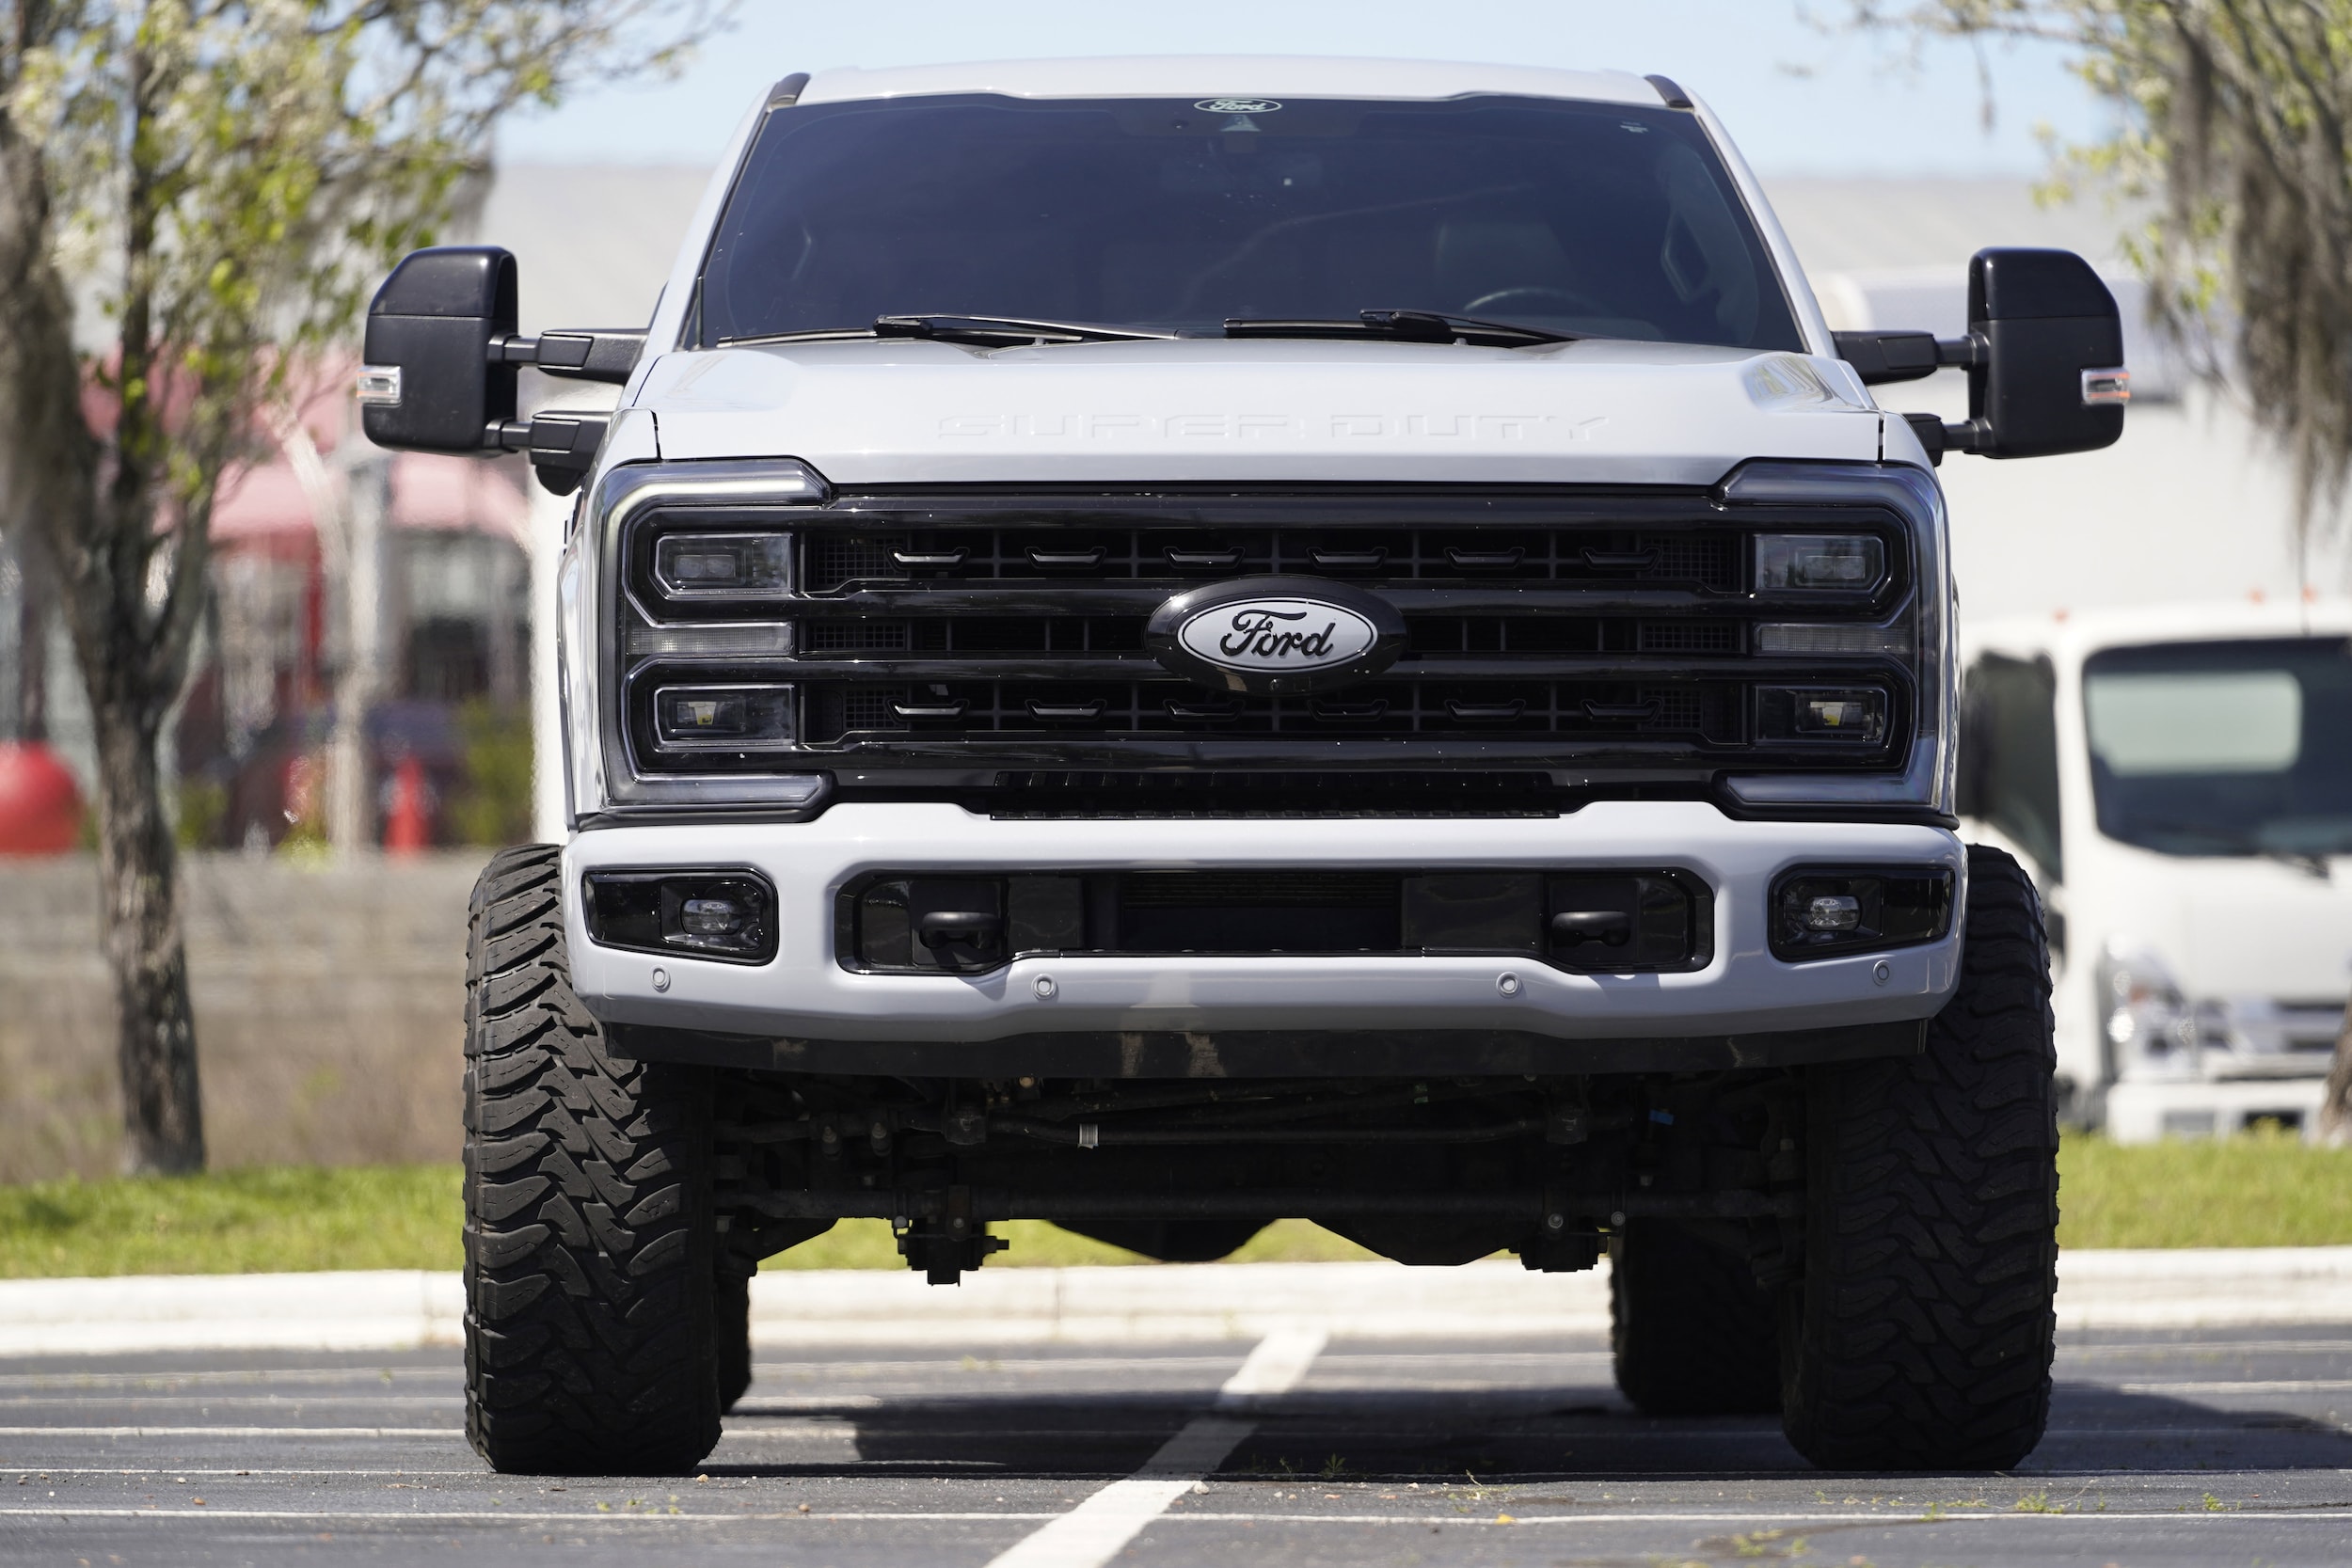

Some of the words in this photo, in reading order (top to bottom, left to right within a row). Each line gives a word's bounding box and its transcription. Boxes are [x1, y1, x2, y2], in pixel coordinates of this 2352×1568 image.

[1209, 99, 1267, 111] Ford
[937, 414, 1306, 441] SUPER
[1329, 414, 1611, 441] DUTY
[1220, 609, 1336, 657] Ford
